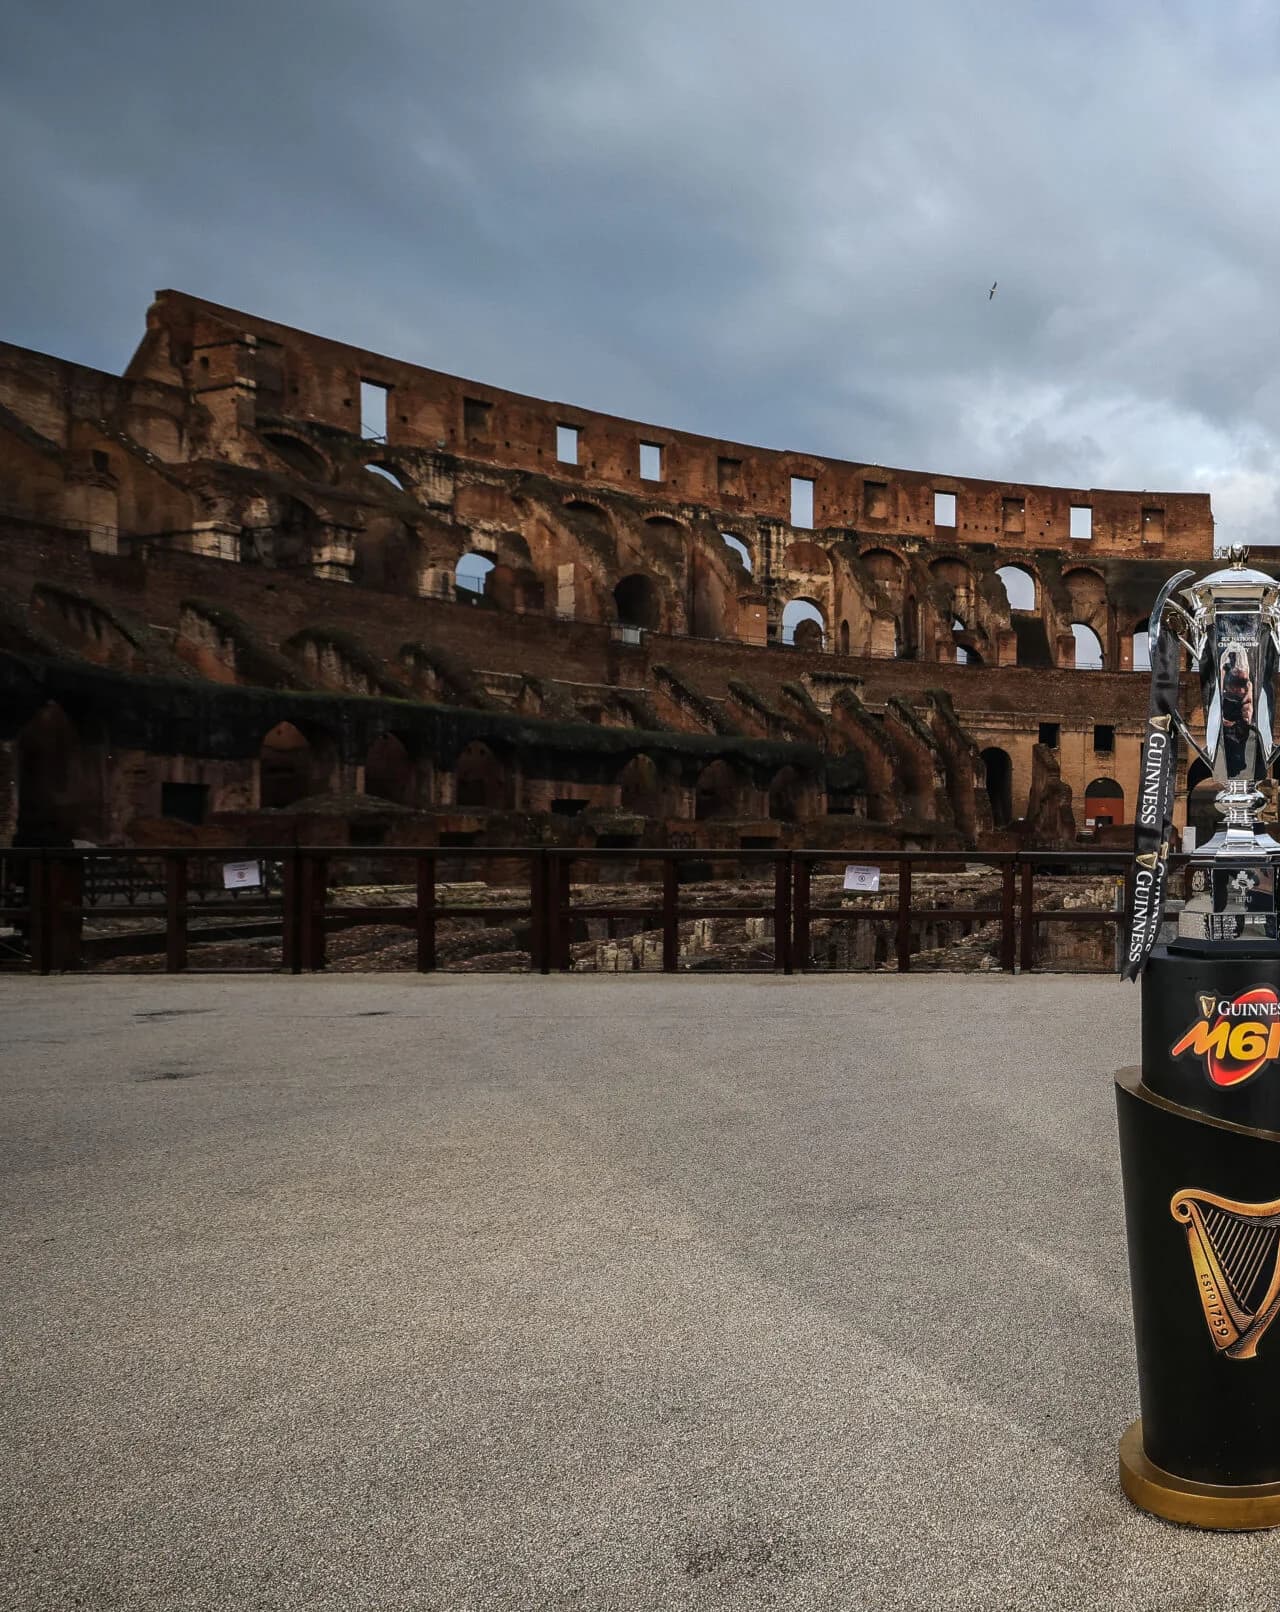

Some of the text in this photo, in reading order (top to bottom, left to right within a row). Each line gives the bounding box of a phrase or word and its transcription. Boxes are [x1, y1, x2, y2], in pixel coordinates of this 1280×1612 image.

[1141, 732, 1167, 825] GUINNESS
[1128, 870, 1154, 962] GUINNESS
[1208, 1303, 1229, 1337] 1759
